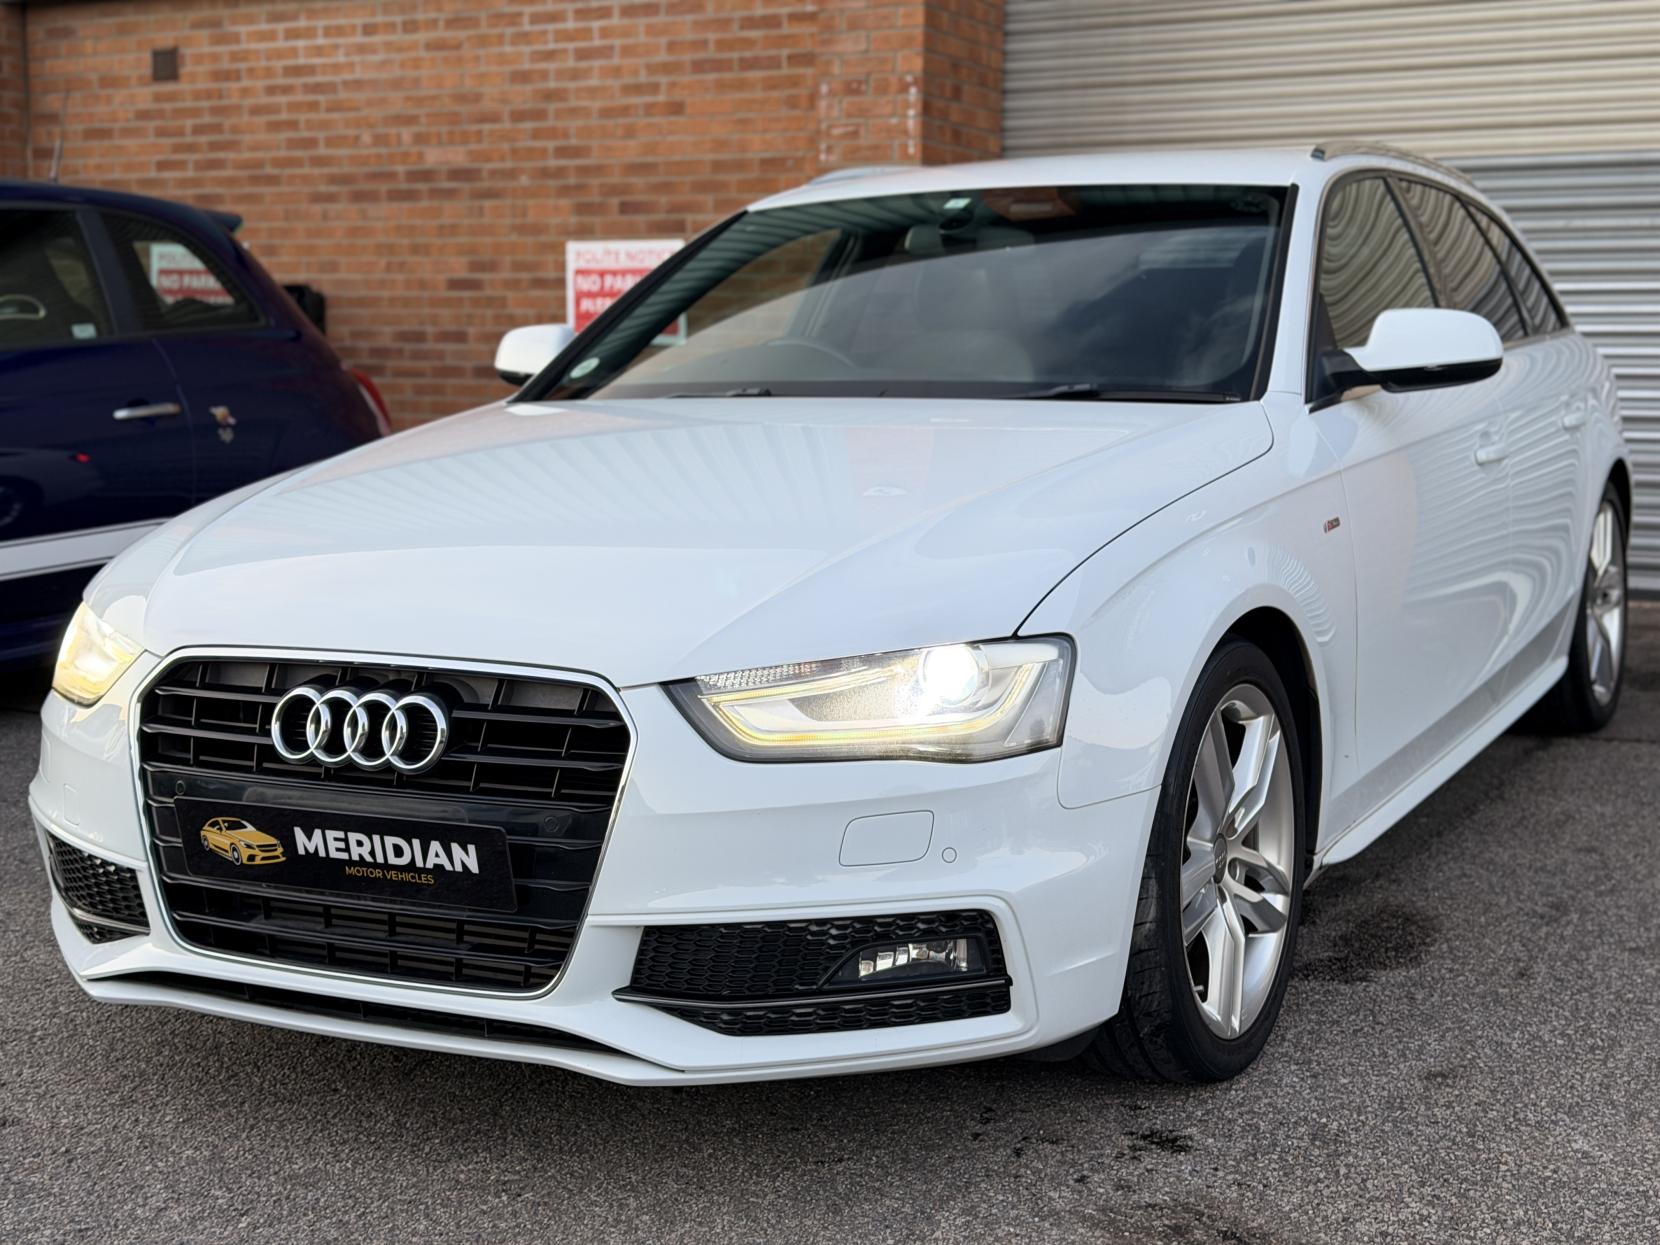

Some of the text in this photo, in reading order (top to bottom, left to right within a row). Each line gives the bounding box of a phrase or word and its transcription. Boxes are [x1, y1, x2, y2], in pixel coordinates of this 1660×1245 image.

[575, 249, 620, 264] POLITE
[158, 273, 181, 290] NO
[575, 273, 602, 293] NO
[293, 826, 480, 875] MERIDIAN
[345, 866, 435, 885] MOTOR VEHICLES
